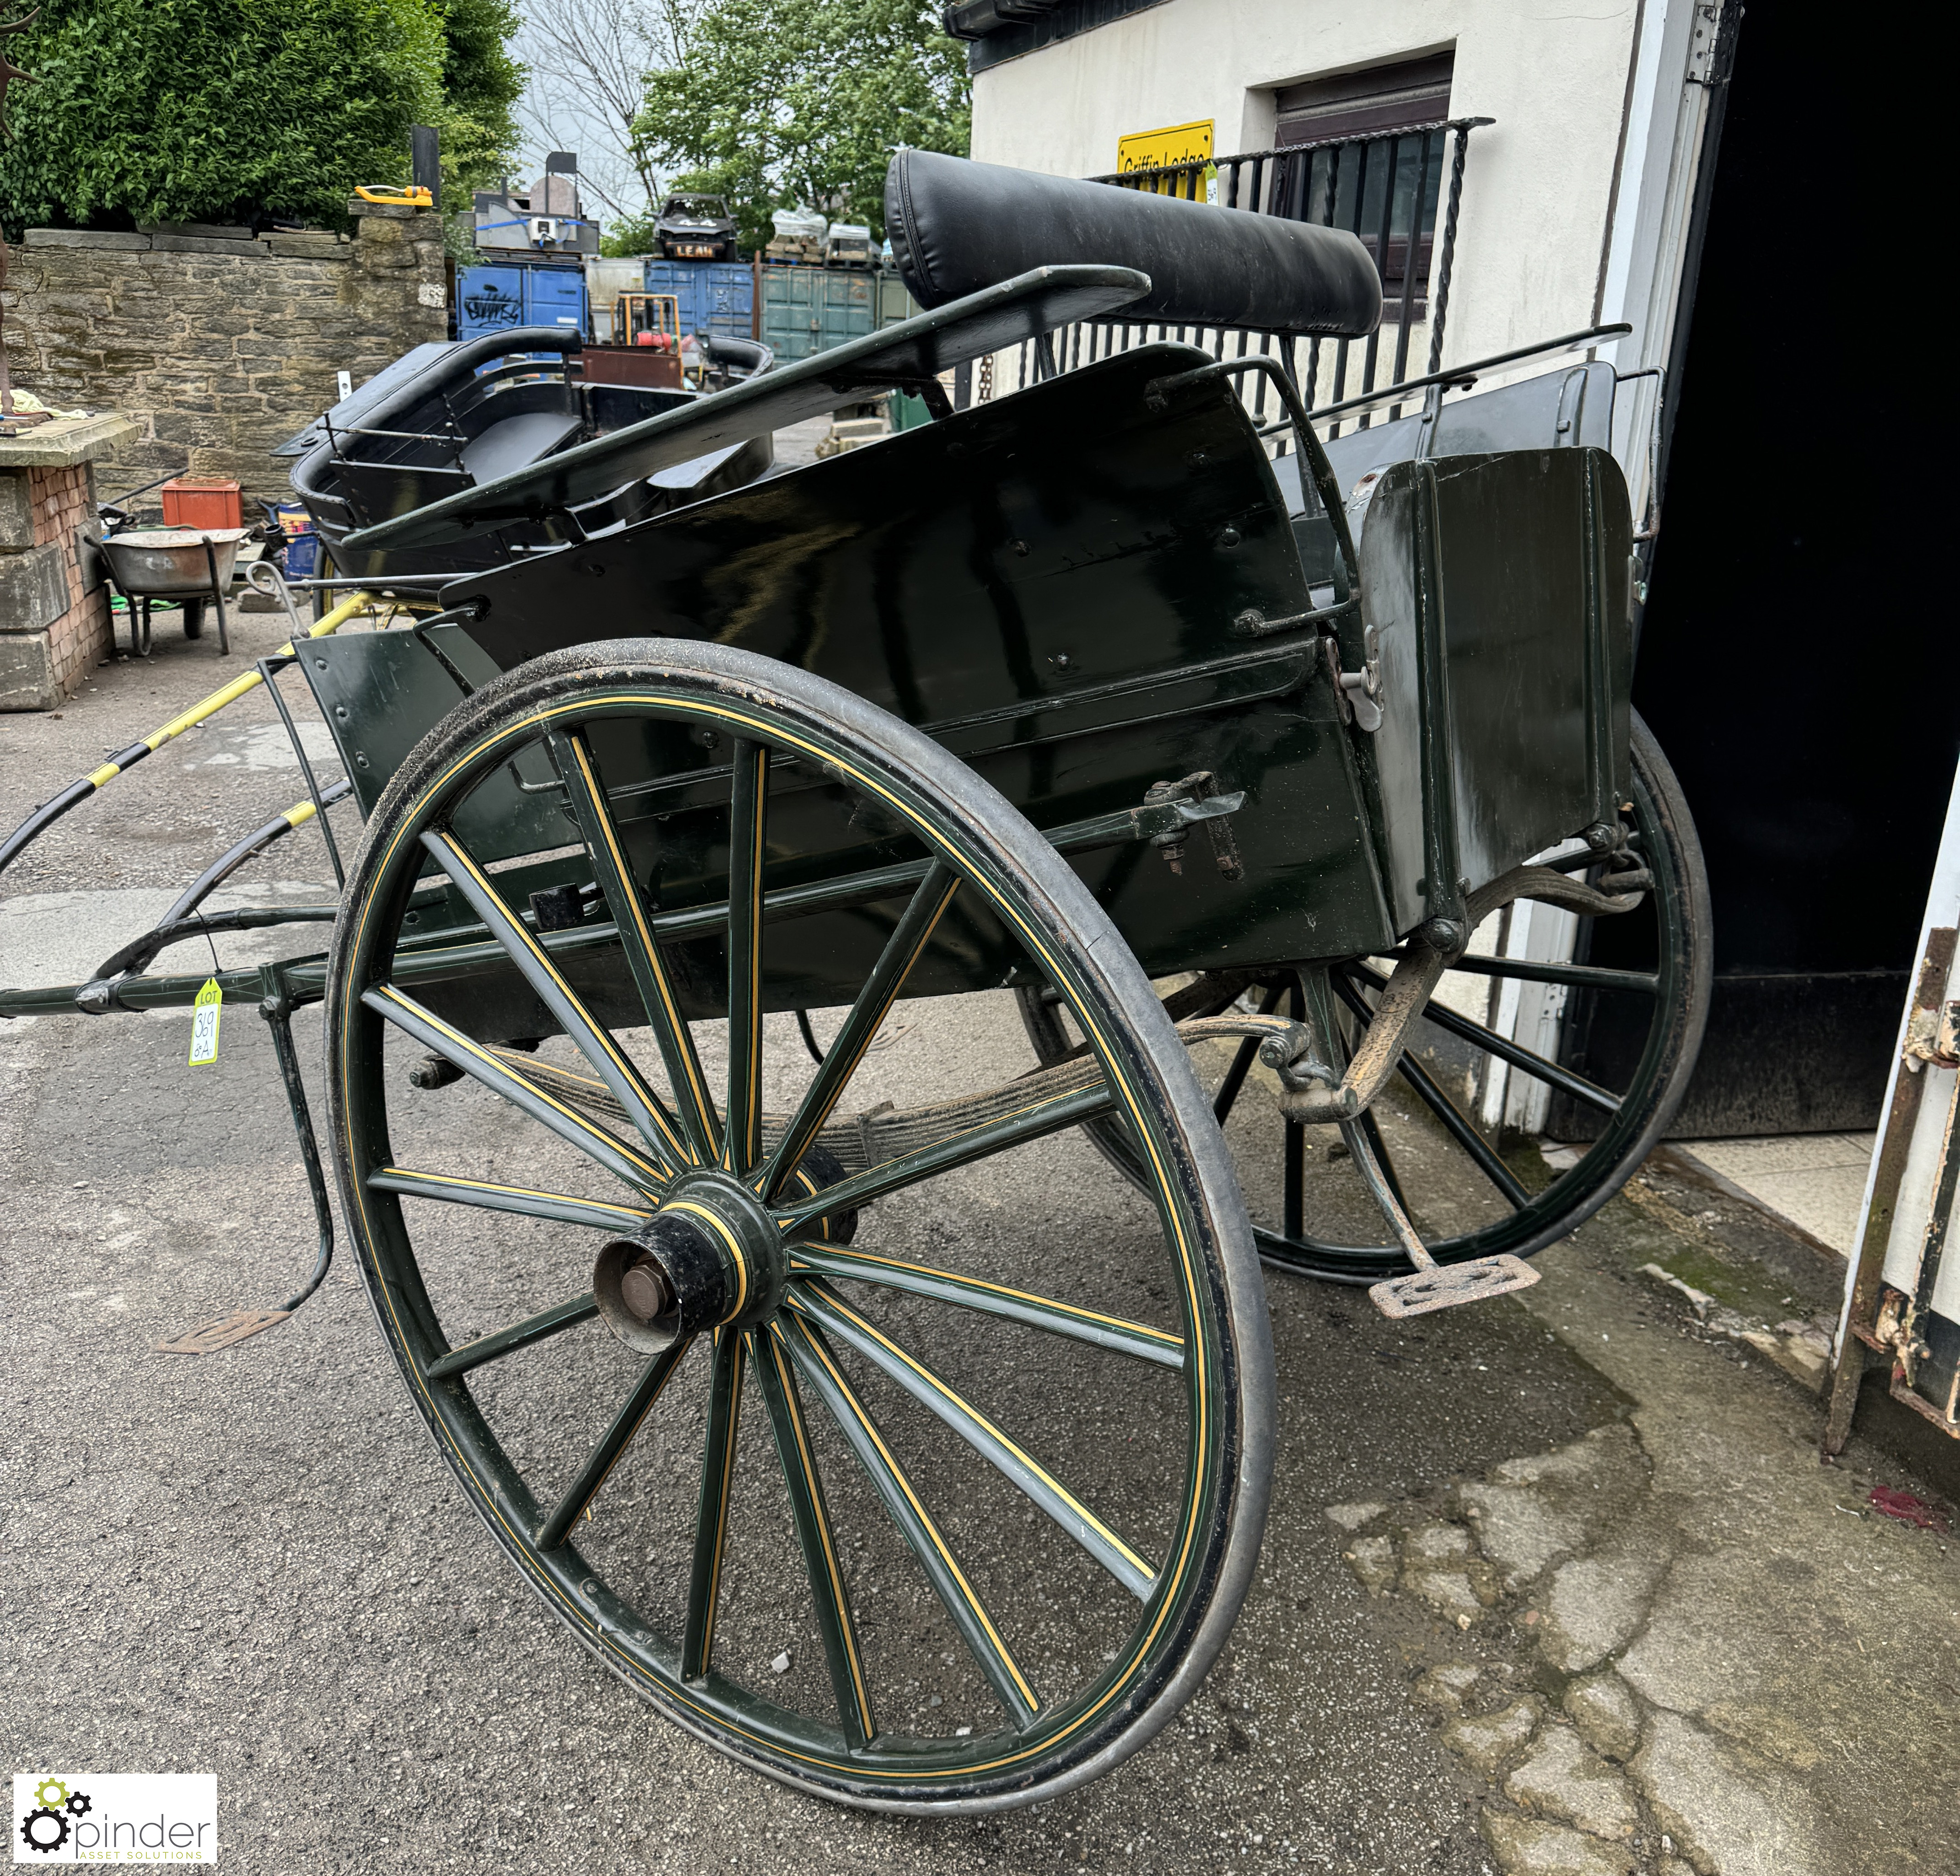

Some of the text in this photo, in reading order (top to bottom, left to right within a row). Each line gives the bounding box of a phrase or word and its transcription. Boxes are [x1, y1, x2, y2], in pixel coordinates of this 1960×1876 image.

[1124, 152, 1161, 184] Griffin
[200, 991, 217, 1004] LOT
[195, 1011, 214, 1038] 369
